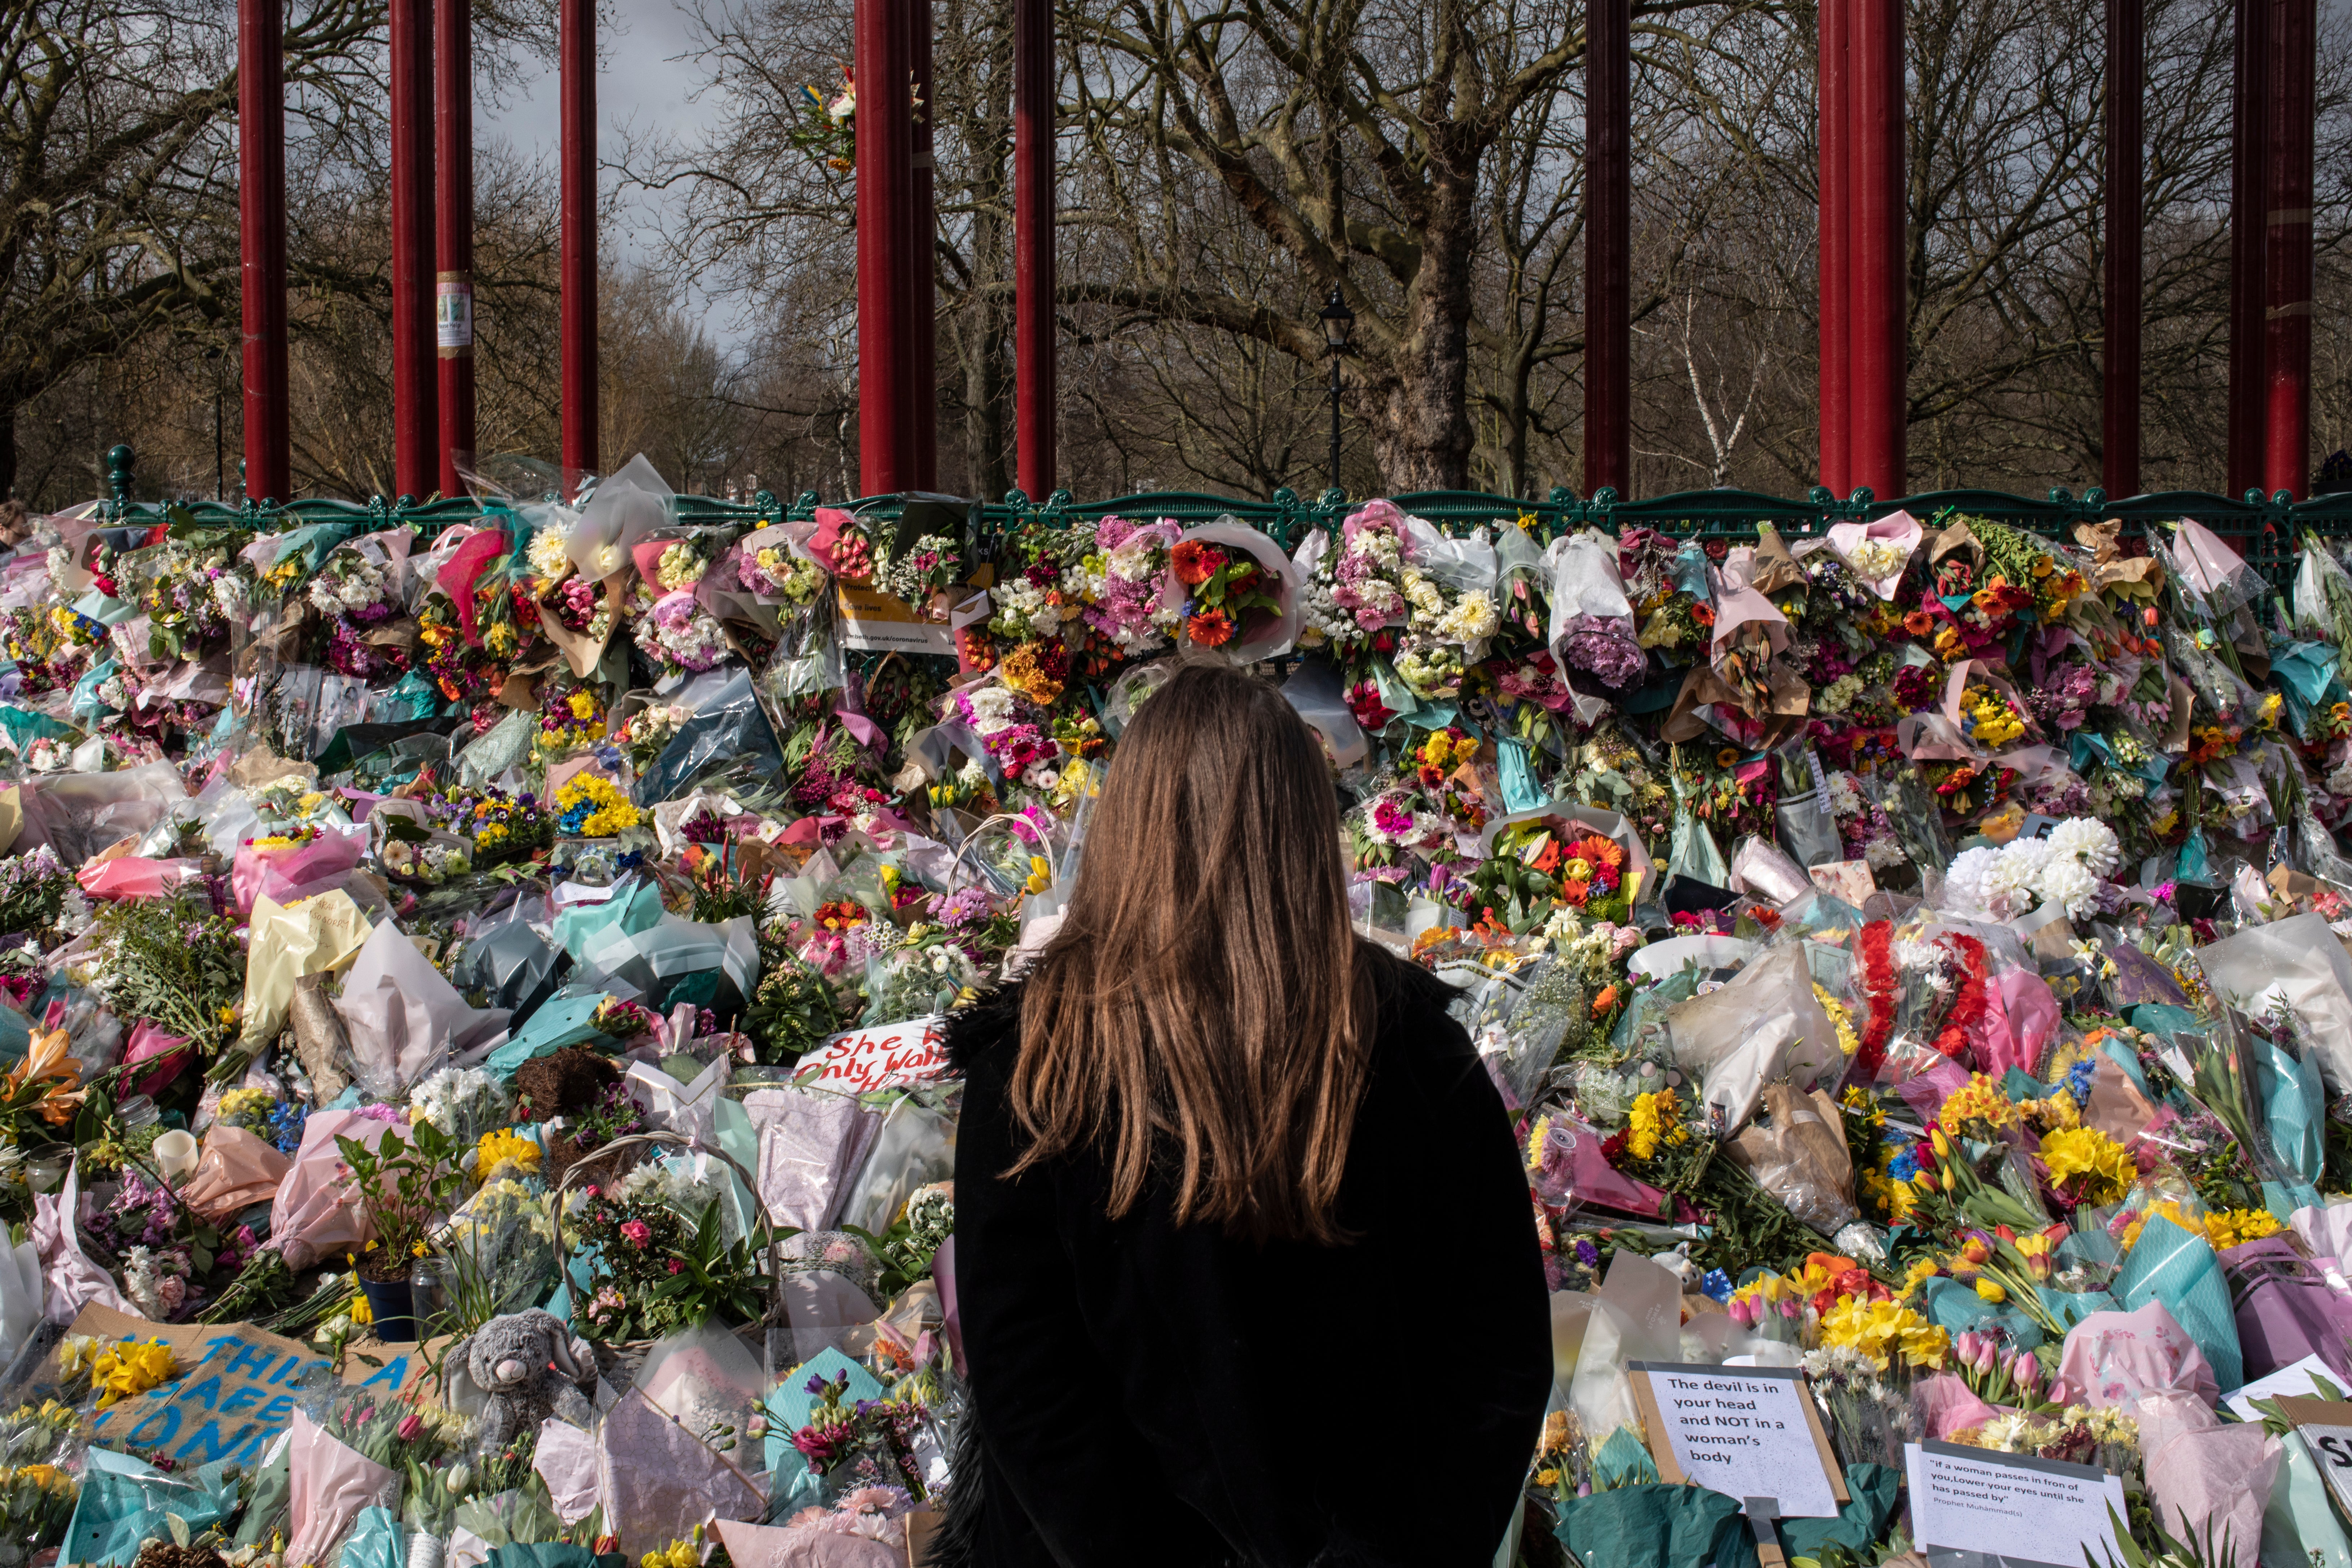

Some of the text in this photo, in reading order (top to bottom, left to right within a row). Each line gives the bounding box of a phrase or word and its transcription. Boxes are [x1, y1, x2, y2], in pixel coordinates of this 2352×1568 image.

[312, 897, 337, 912] SARAH
[322, 917, 349, 930] SORRY
[826, 1034, 903, 1059] She
[794, 1058, 878, 1083] Only
[855, 1069, 959, 1095] Hom
[361, 1355, 409, 1391] A
[1668, 1379, 1779, 1393] The devil is in
[1674, 1398, 1756, 1410] your head
[1680, 1416, 1710, 1426] and
[1715, 1417, 1750, 1427] NOT
[1755, 1418, 1771, 1428] in
[1685, 1434, 1760, 1446] woman's
[1690, 1450, 1731, 1464] body
[2318, 1436, 2352, 1467] S
[1930, 1459, 1942, 1468] "if
[1954, 1466, 1992, 1476] woman
[1995, 1473, 2028, 1482] passes
[2032, 1475, 2041, 1484] in
[2044, 1479, 2066, 1488] fron
[1931, 1474, 1985, 1486] you,Lower
[2040, 1490, 2063, 1500] until
[1933, 1484, 2008, 1503] has passed by"
[1934, 1497, 2022, 1517] Prophet Muhammad(s)
